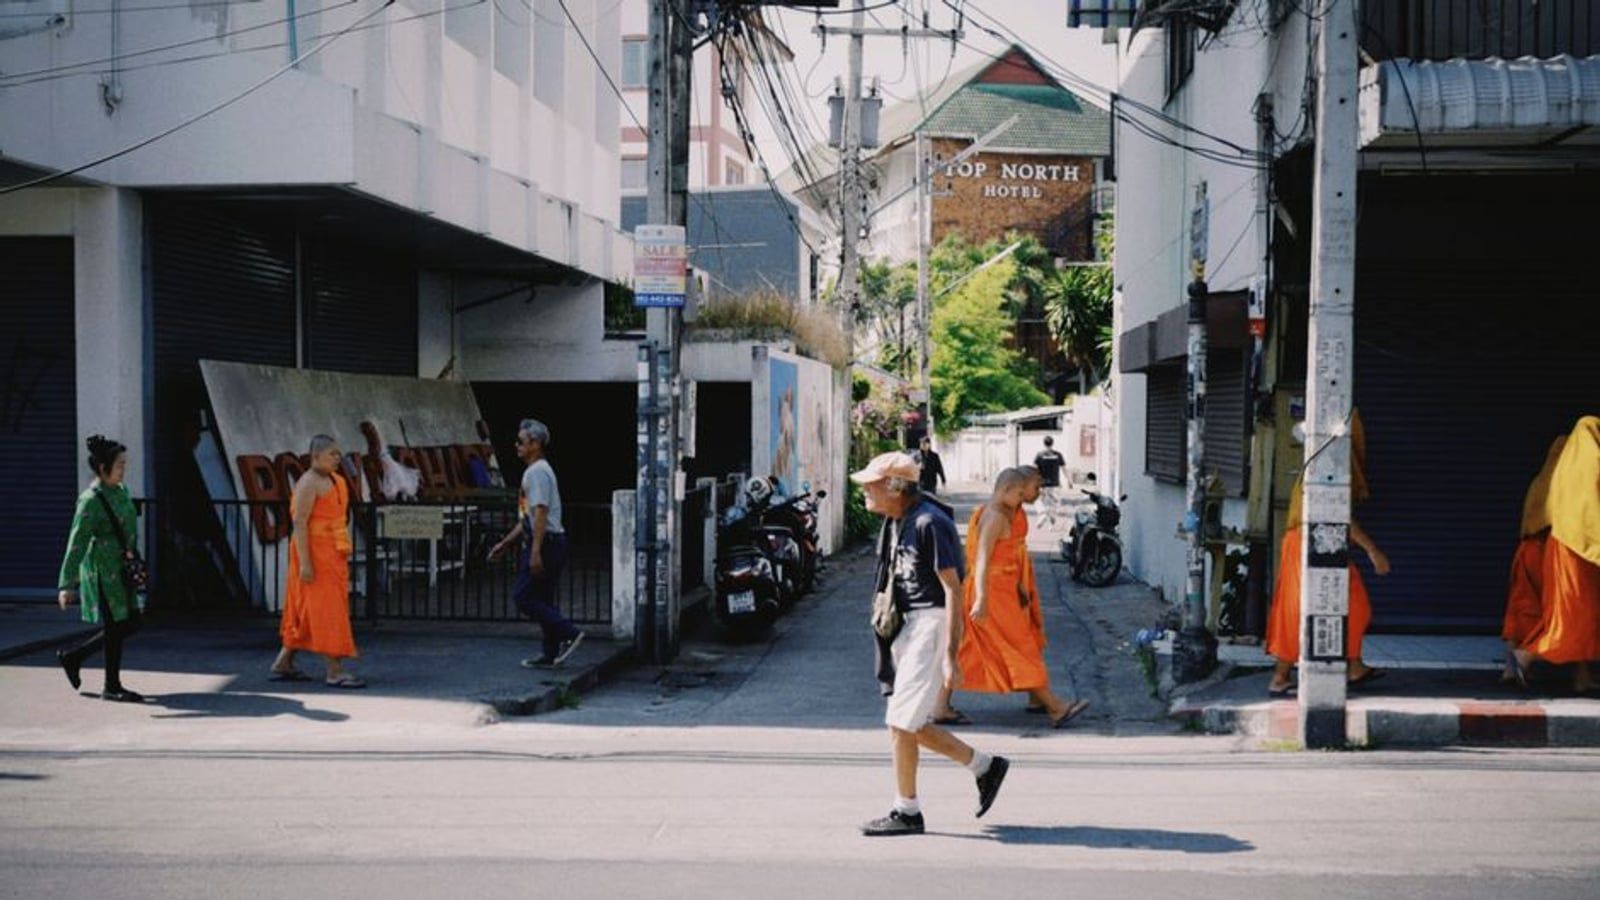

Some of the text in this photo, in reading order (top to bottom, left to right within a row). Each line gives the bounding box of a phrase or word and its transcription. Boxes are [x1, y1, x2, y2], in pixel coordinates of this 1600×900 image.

[945, 161, 1080, 181] TOP NORTH
[984, 185, 1042, 198] HOTEL
[642, 245, 679, 257] SALE
